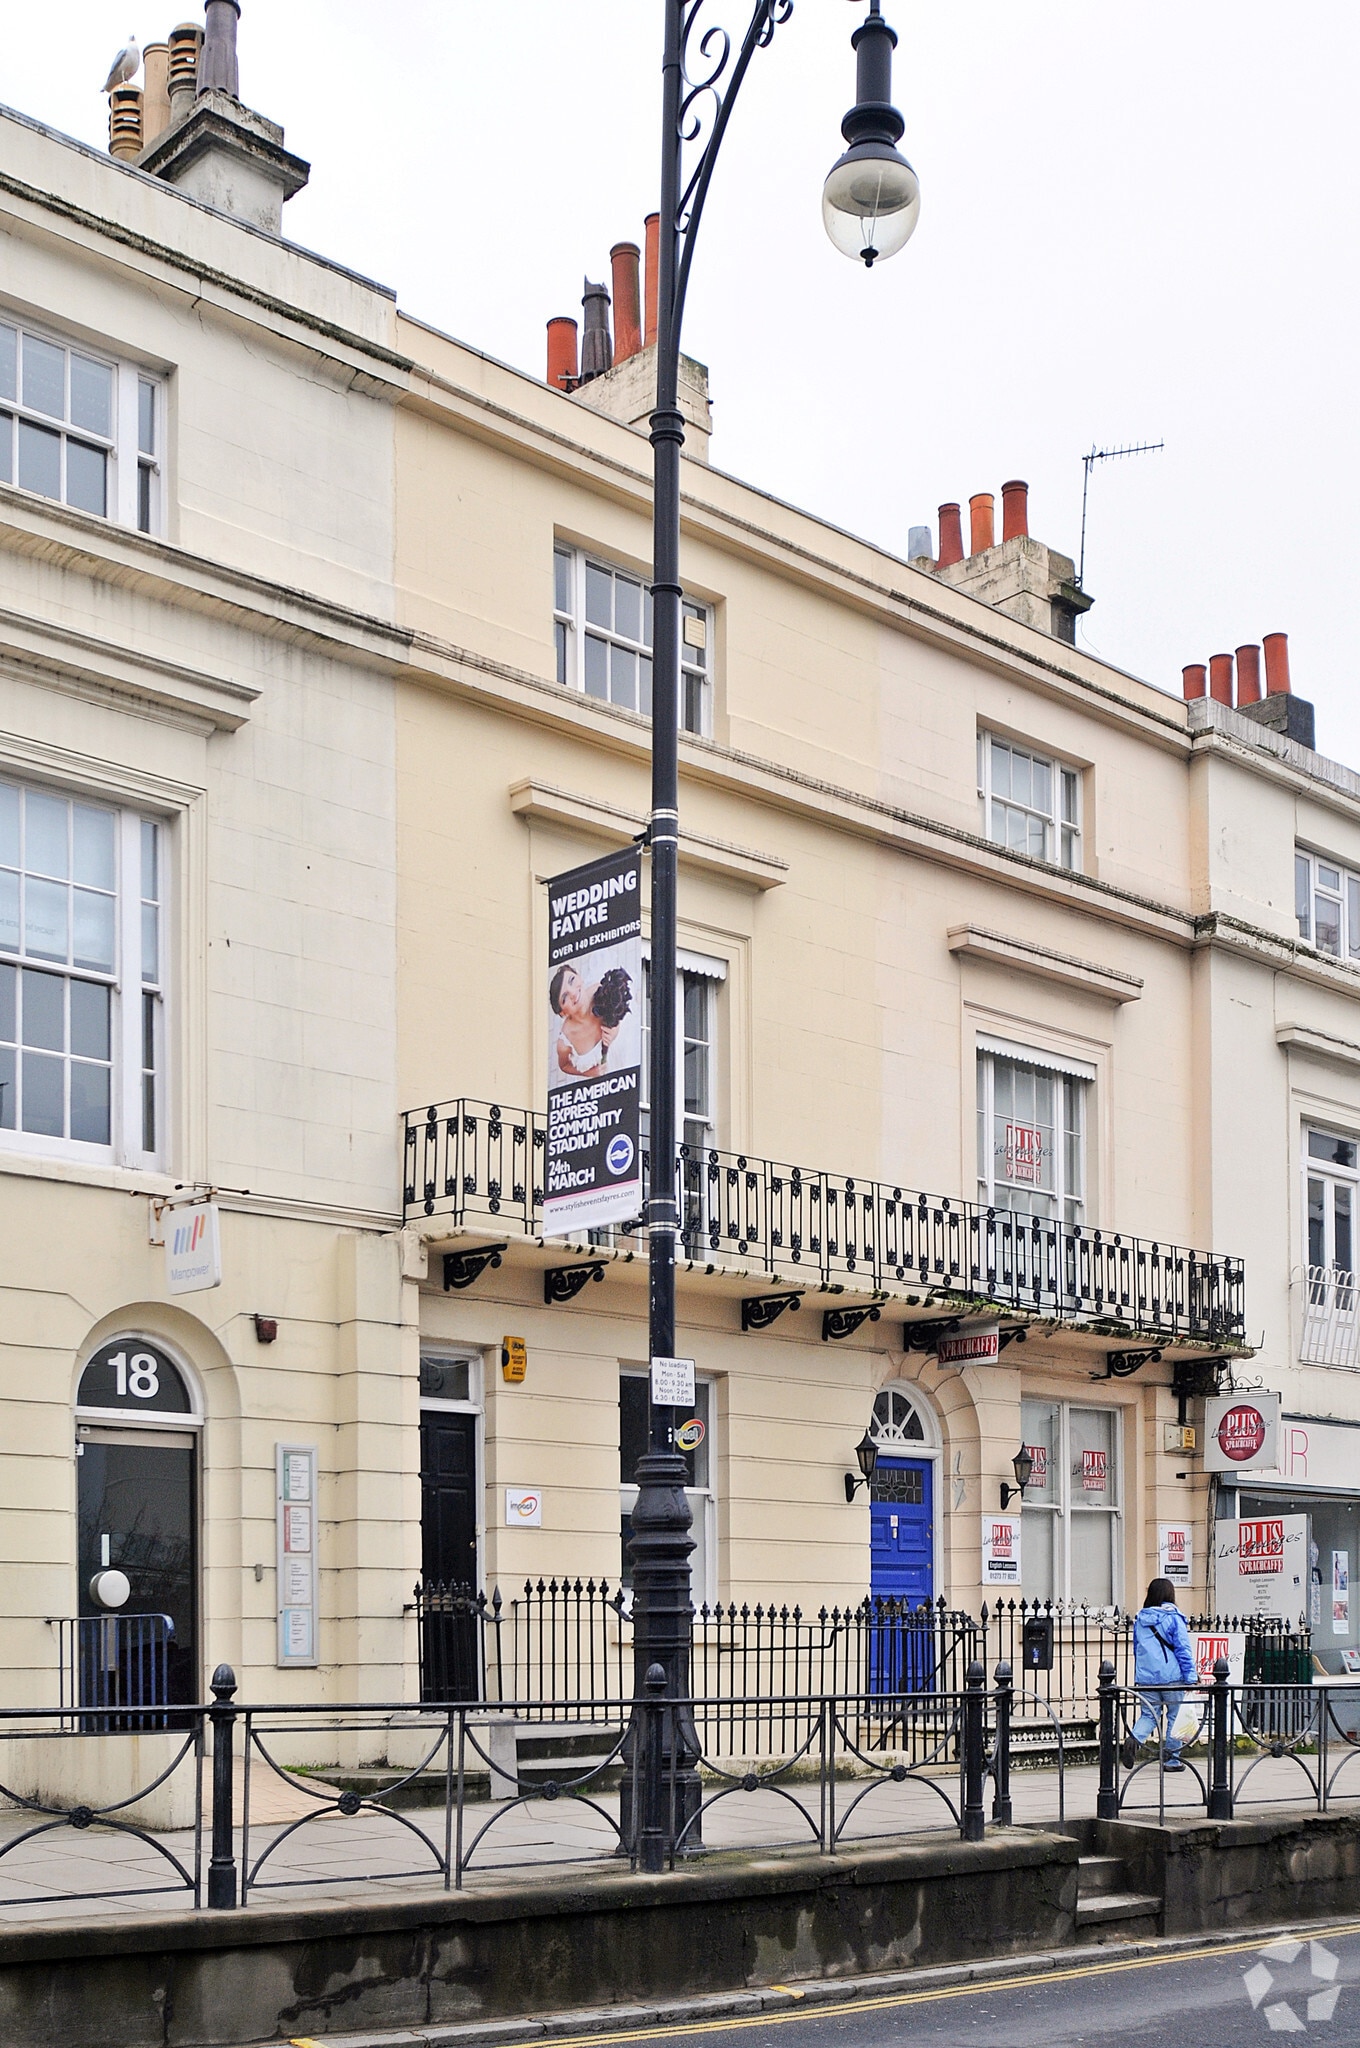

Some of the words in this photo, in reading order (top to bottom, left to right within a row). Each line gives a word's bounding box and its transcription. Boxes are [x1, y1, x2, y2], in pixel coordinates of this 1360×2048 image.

[552, 870, 637, 918] WEDDING
[552, 902, 608, 940] FAYRE
[552, 943, 574, 960] OVER
[575, 938, 589, 952] 140
[589, 919, 641, 946] EXHIBITORS
[550, 1091, 573, 1110] THE
[574, 1073, 637, 1103] AMERICAN
[549, 1108, 623, 1141] COMMUNITY
[550, 1100, 599, 1126] EXPRESS
[549, 1130, 600, 1157] STADIUM
[1007, 1127, 1041, 1166] PLUS
[549, 1159, 571, 1177] 24th
[549, 1167, 596, 1192] MARCH
[170, 1264, 209, 1281] Manpower
[107, 1352, 159, 1398] 18
[1226, 1412, 1258, 1437] PLUS
[1083, 1452, 1105, 1477] PLUS
[993, 1526, 1012, 1546] PLUS
[1169, 1533, 1185, 1551] PLUS
[1219, 1532, 1303, 1558] Languages
[1240, 1522, 1282, 1556] PLUS
[1239, 1559, 1283, 1575] SPRACHCAFFE
